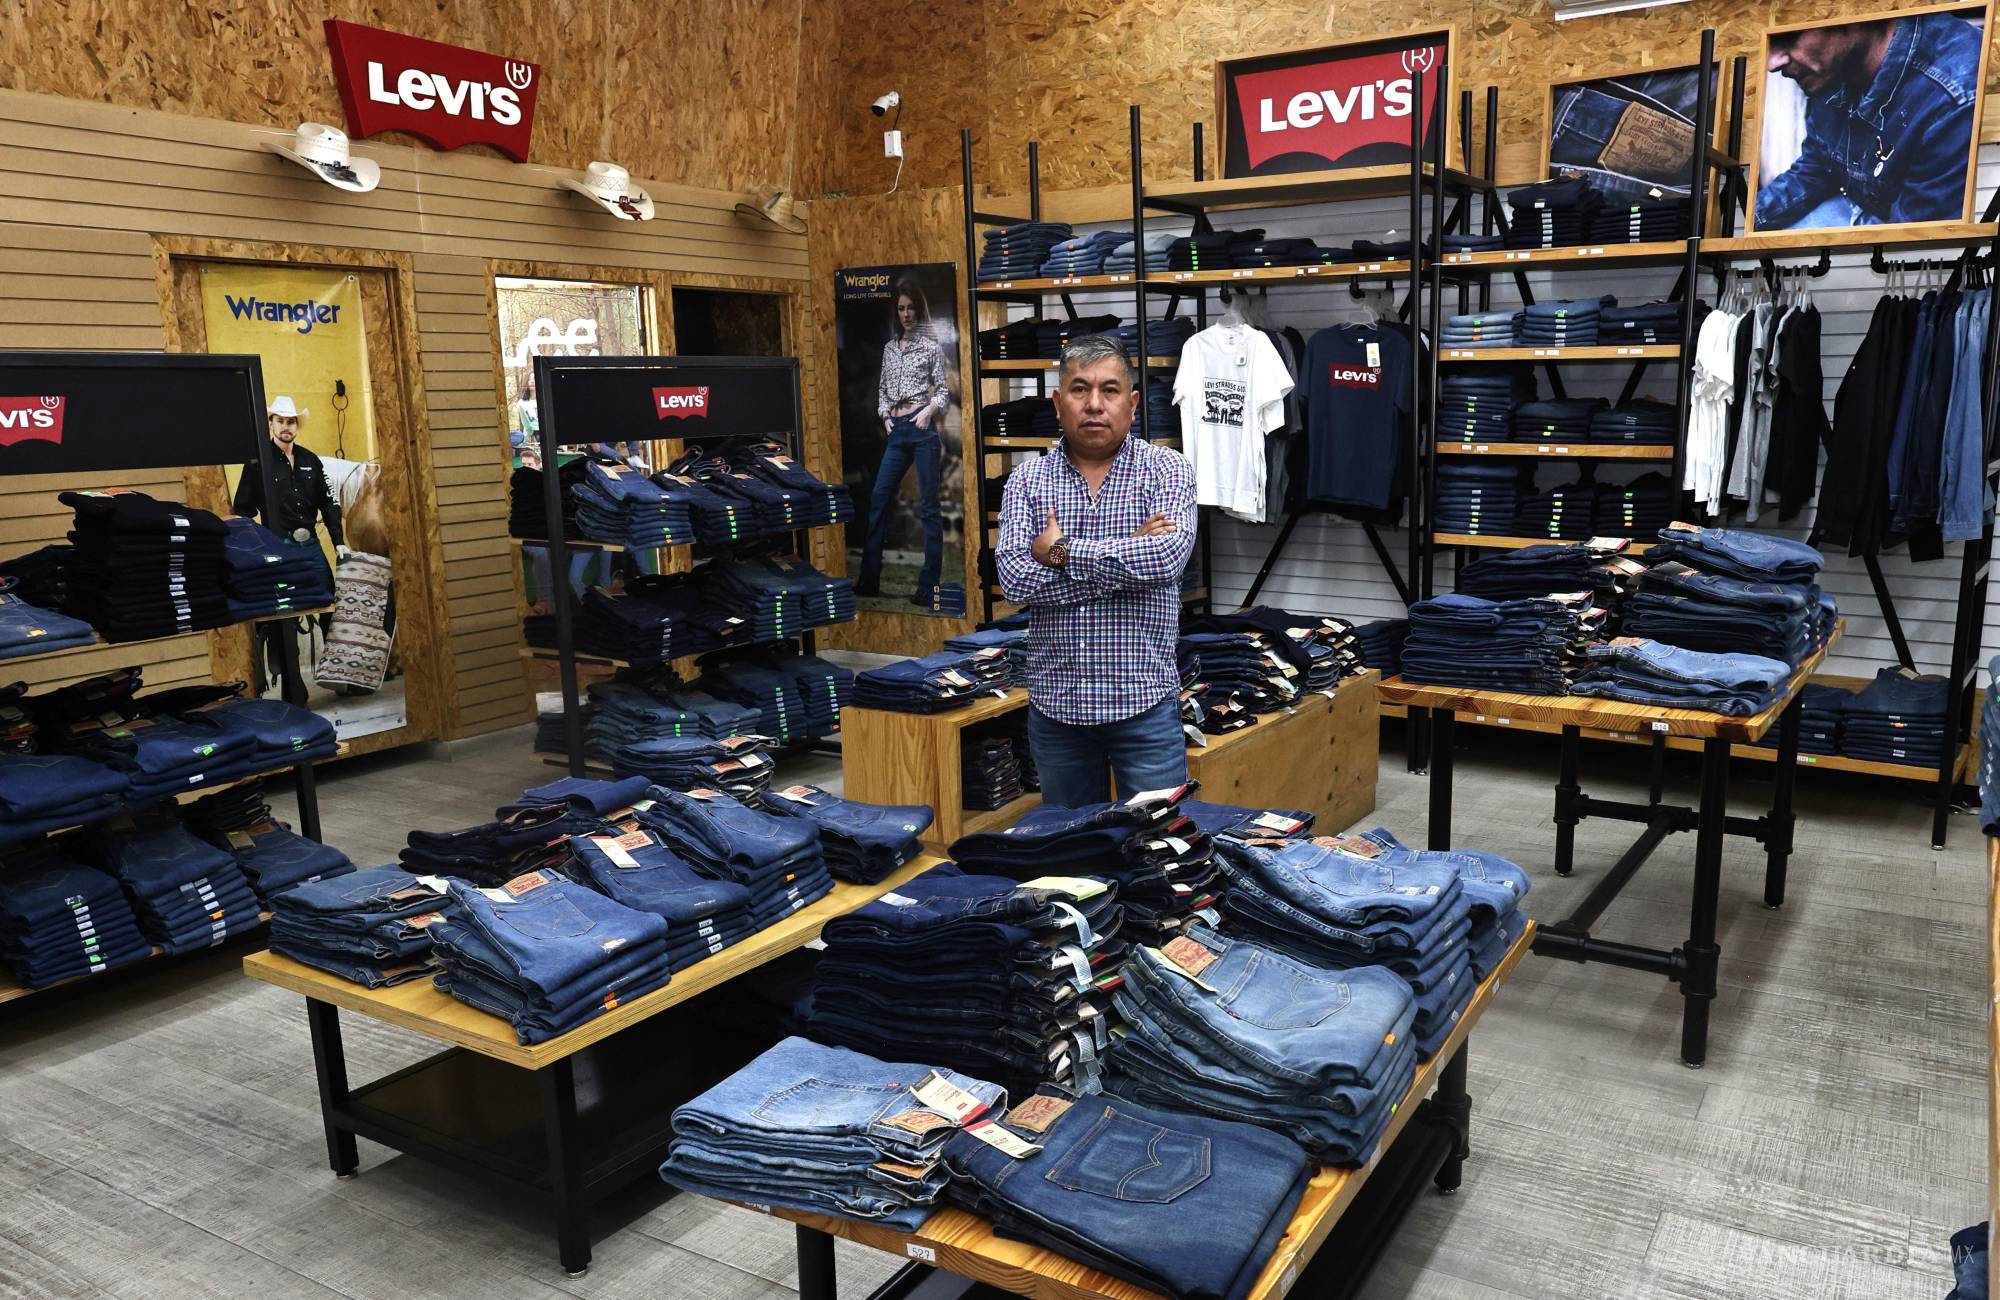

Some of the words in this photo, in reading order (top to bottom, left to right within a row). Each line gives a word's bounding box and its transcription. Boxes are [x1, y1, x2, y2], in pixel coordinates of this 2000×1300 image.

[844, 273, 890, 291] Wrangler
[224, 294, 340, 334] Wrangler
[660, 394, 704, 408] Levi's
